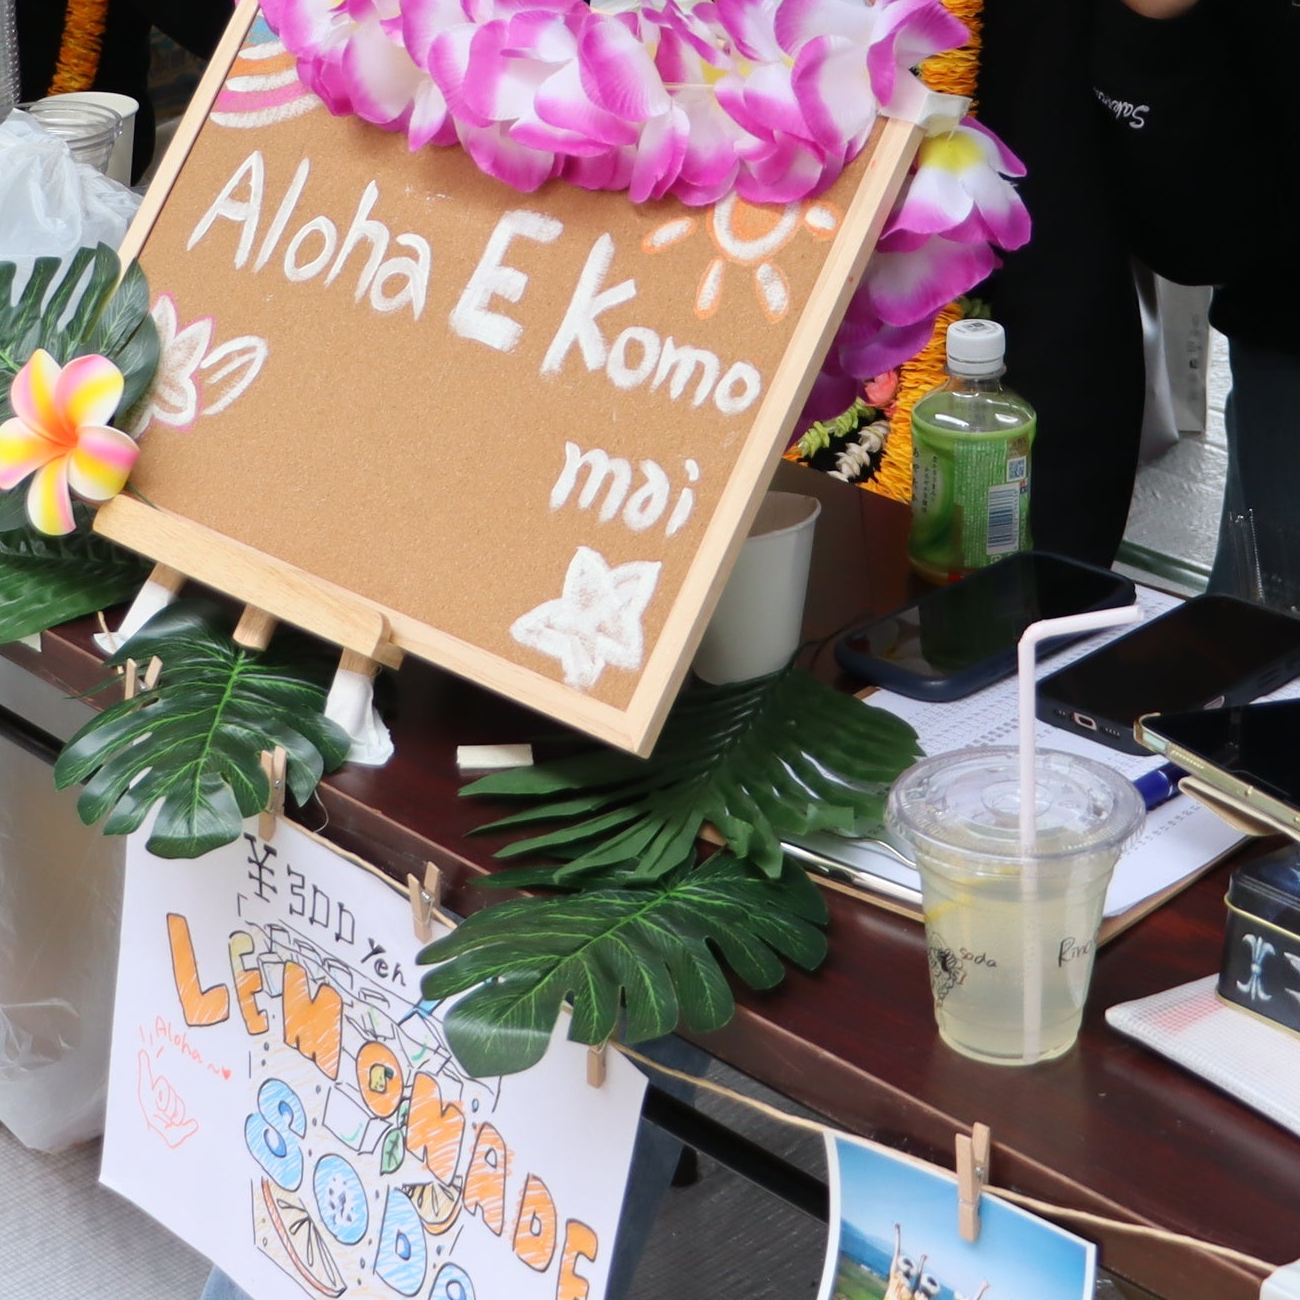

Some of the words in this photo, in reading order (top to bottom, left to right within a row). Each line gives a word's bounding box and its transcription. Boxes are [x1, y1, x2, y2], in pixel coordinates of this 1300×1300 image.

[186, 149, 432, 321] Aloha
[448, 210, 564, 353] E
[549, 440, 700, 538] mai
[244, 833, 356, 946] ¥300
[360, 937, 408, 988] yen
[166, 912, 598, 1300] LEMONADE
